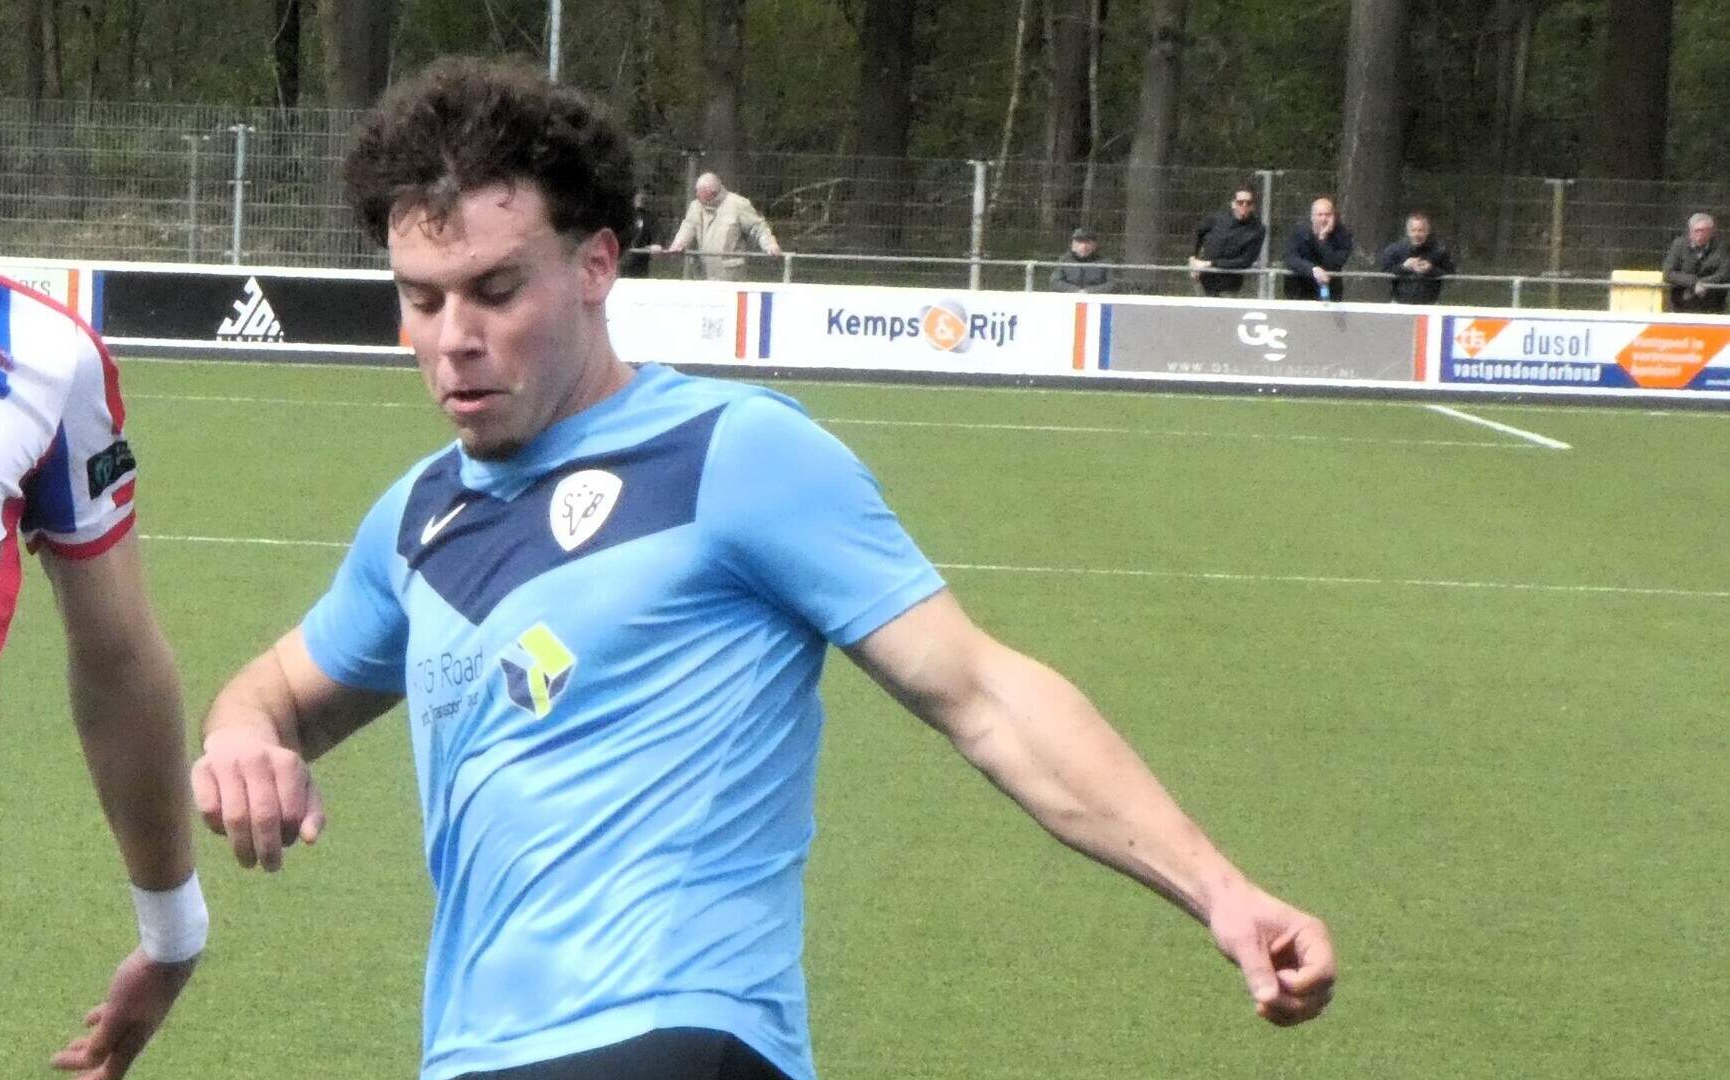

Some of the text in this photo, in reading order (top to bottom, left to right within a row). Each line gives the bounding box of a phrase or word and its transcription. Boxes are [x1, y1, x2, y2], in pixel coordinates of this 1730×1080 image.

[827, 308, 921, 342] Kemps
[969, 312, 1018, 347] Rijf
[1522, 327, 1590, 356] dusol
[440, 646, 483, 688] Road
